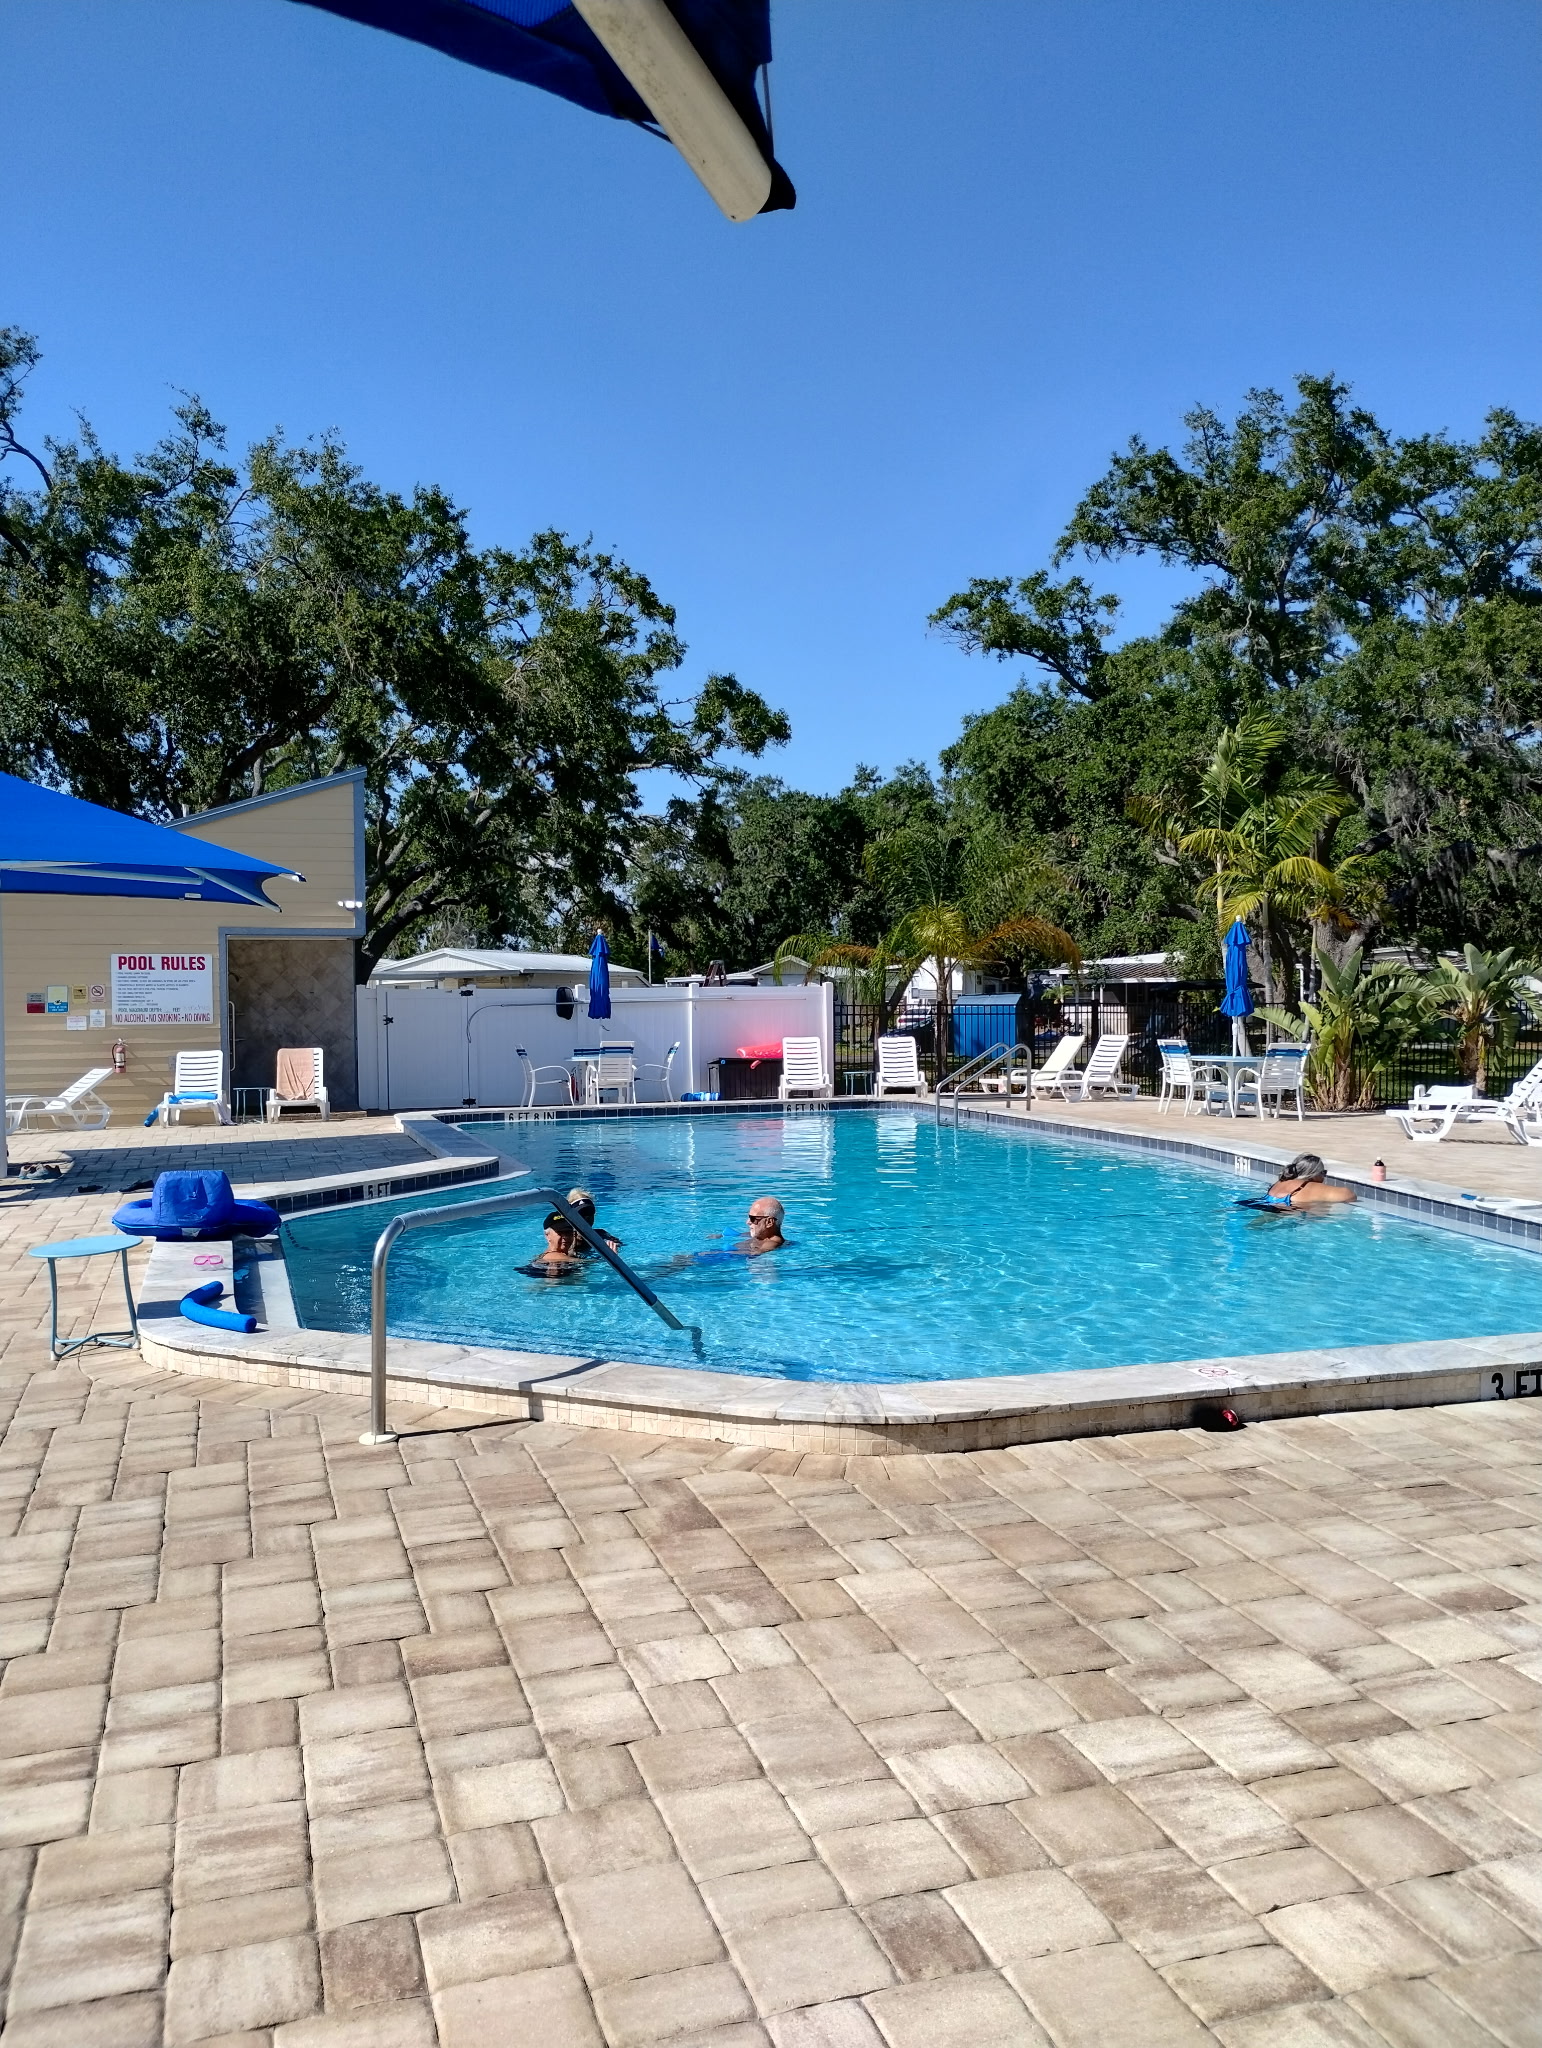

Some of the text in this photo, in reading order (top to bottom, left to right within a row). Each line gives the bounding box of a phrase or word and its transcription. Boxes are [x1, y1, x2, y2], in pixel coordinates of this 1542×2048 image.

[117, 956, 206, 970] POOL RULES
[115, 1013, 123, 1023] NO
[157, 1013, 181, 1023] SMOKING
[184, 1013, 193, 1022] NO
[193, 1012, 211, 1022] DIVING
[795, 1103, 806, 1111] FT
[817, 1103, 828, 1111] IN
[518, 1112, 530, 1120] FT
[543, 1111, 555, 1119] IN
[377, 1181, 390, 1197] FT
[1515, 1369, 1542, 1398] FT
